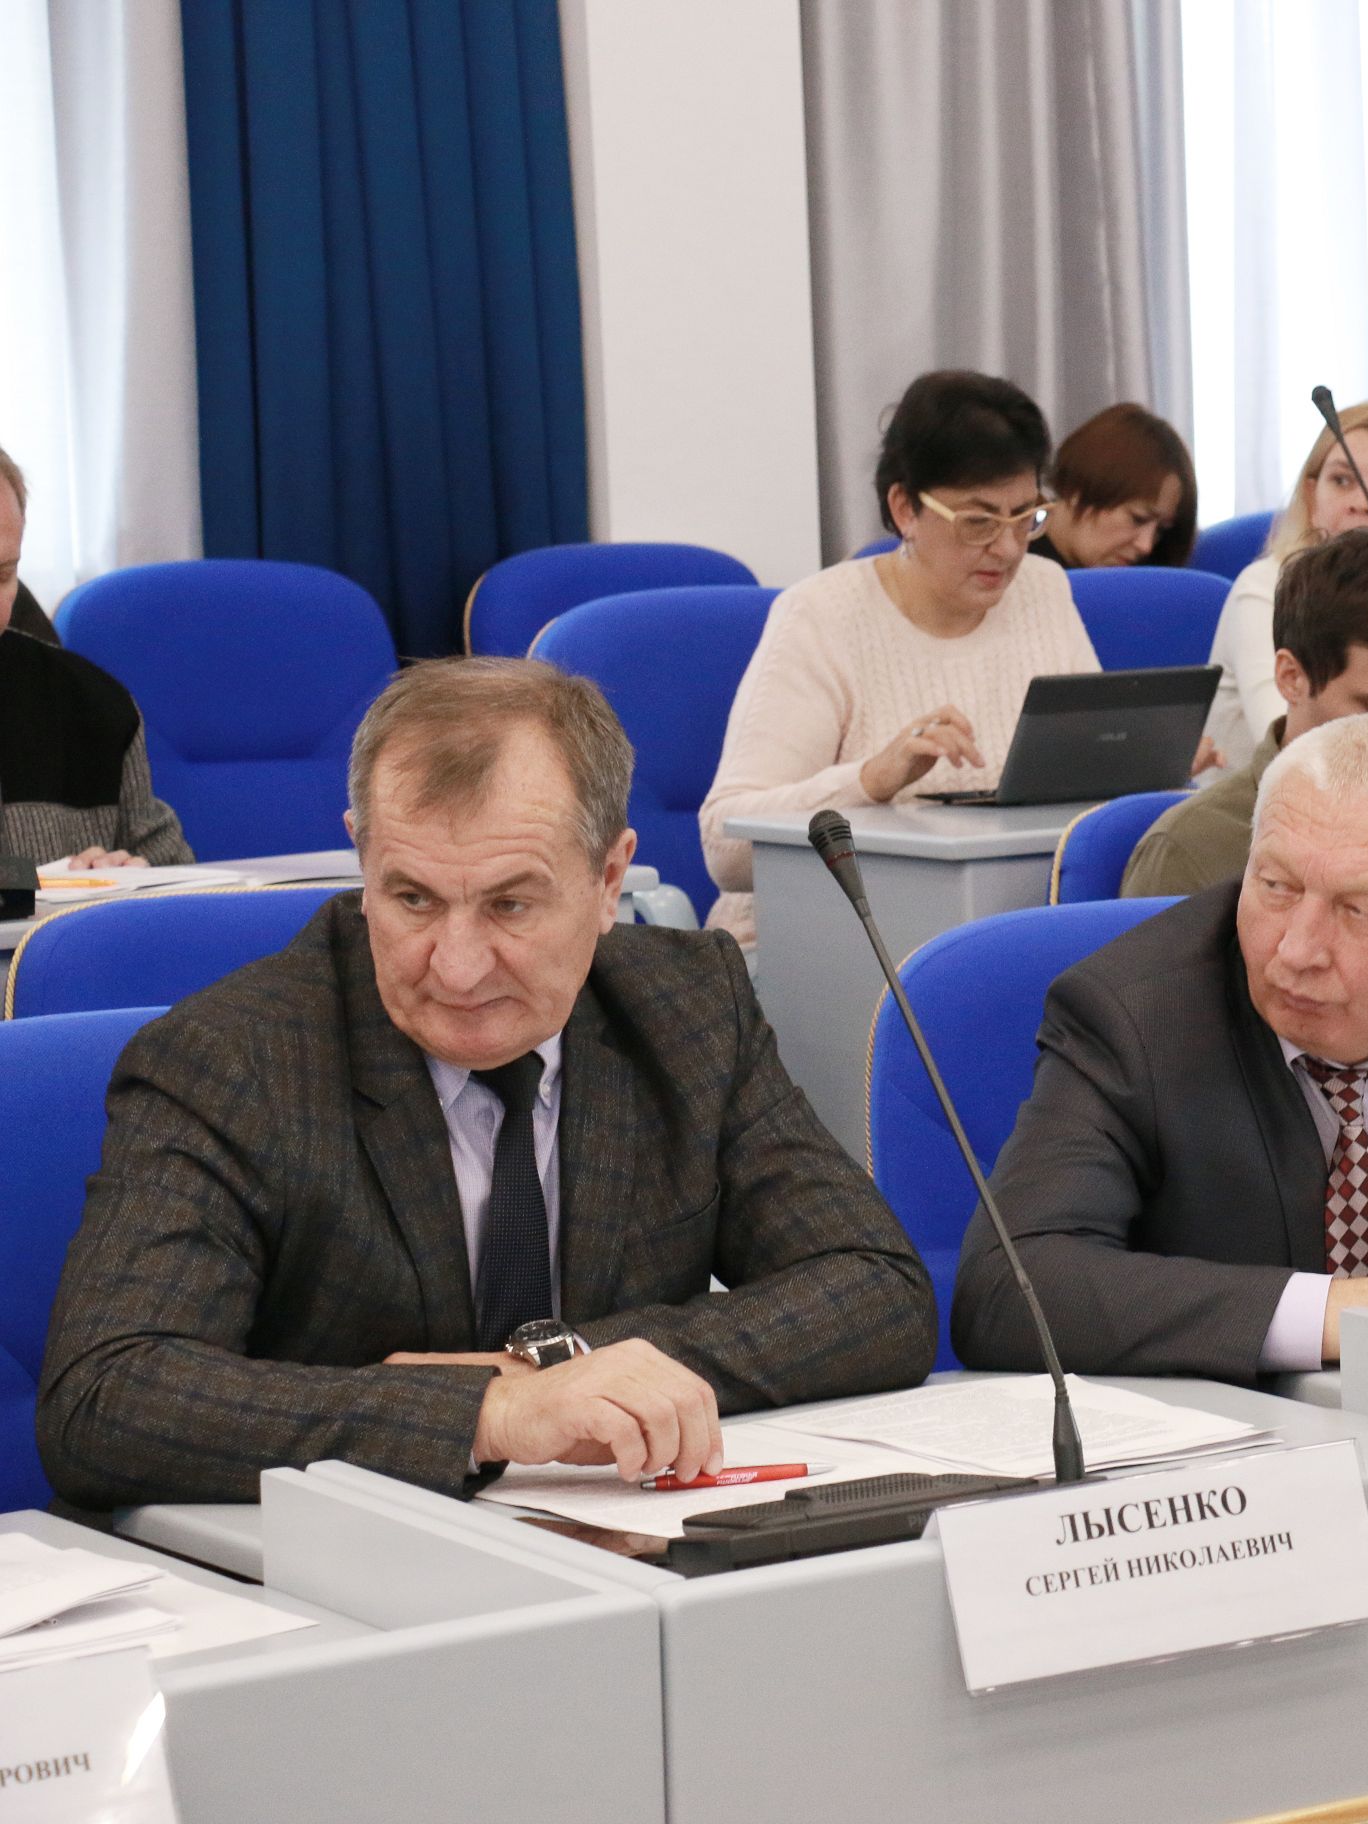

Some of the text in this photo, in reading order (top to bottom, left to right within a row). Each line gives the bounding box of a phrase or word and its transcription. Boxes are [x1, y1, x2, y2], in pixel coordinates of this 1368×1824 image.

[1056, 1485, 1248, 1546] ЛЫСЕНКО
[1025, 1531, 1295, 1597] СЕРГЕЙ НИКОЛАЕВИЧ
[0, 1752, 91, 1788] РОВИЧ
